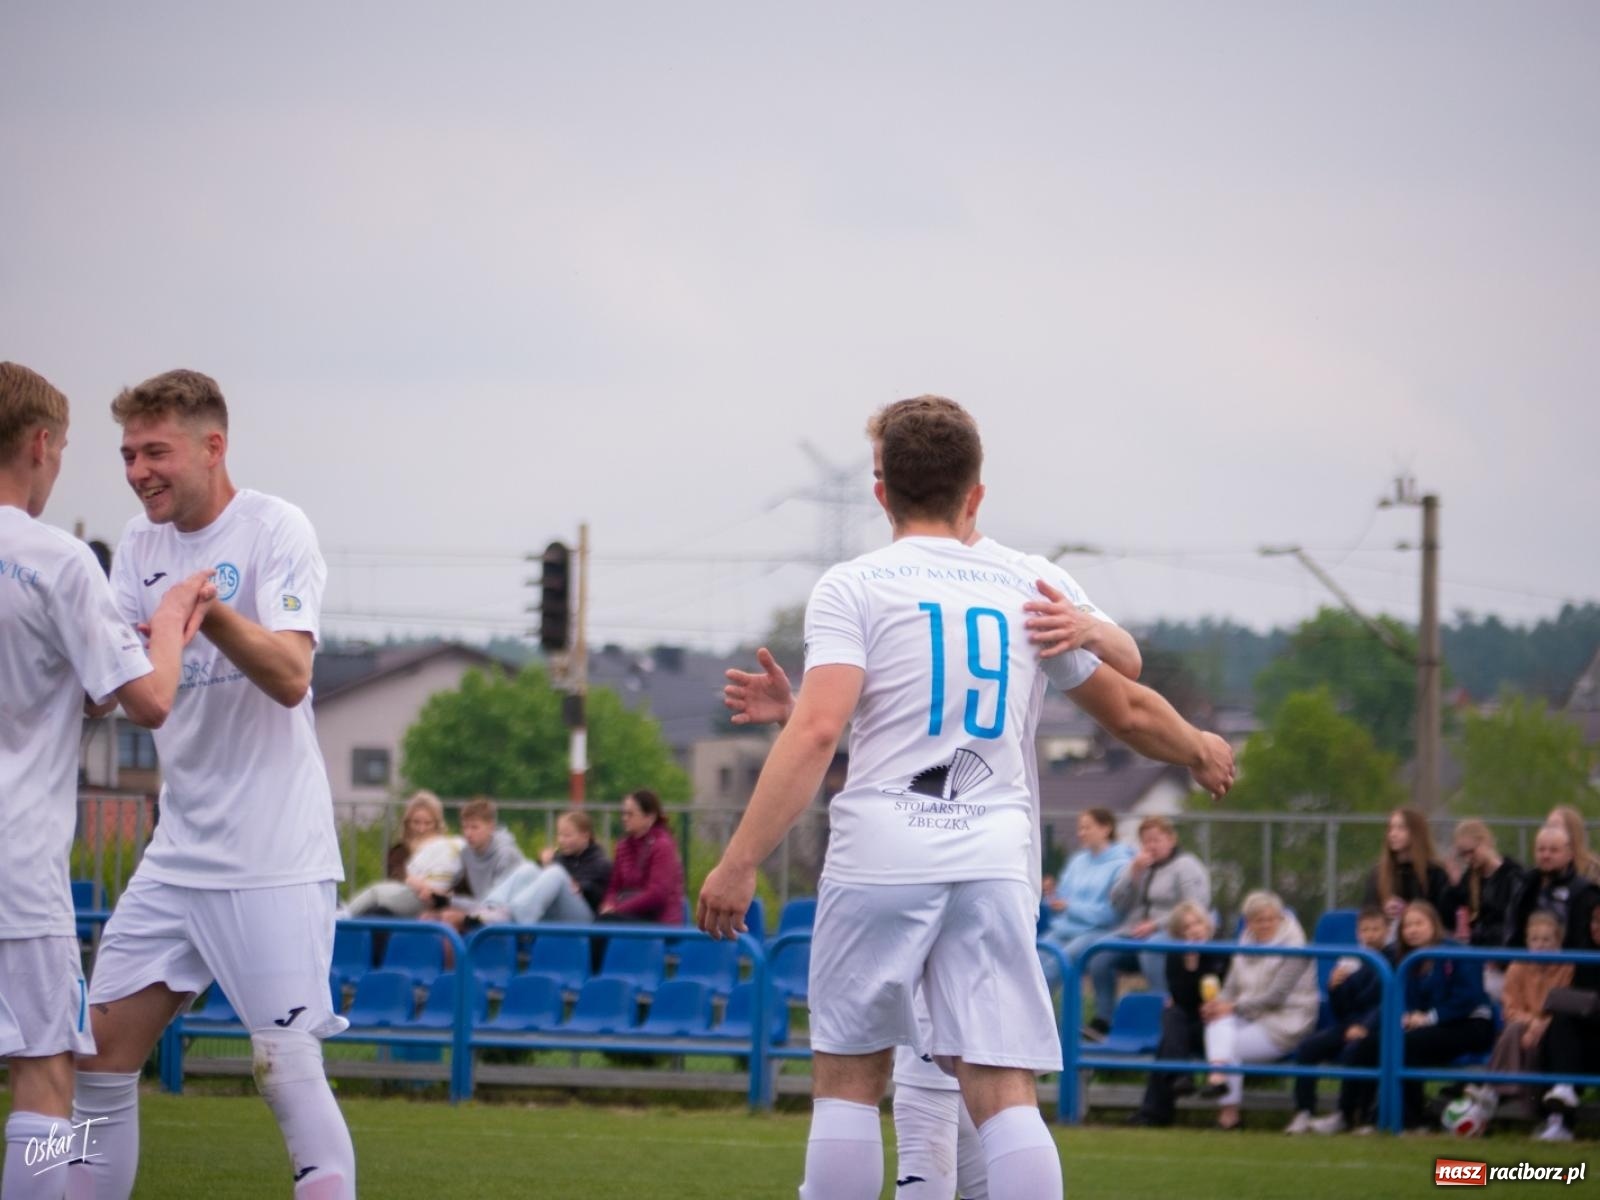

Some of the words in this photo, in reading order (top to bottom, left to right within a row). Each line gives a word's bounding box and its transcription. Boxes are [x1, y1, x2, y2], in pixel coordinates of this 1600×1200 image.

[861, 566, 895, 581] LKS
[918, 601, 1009, 740] 19
[894, 801, 986, 817] STOLARSTWO
